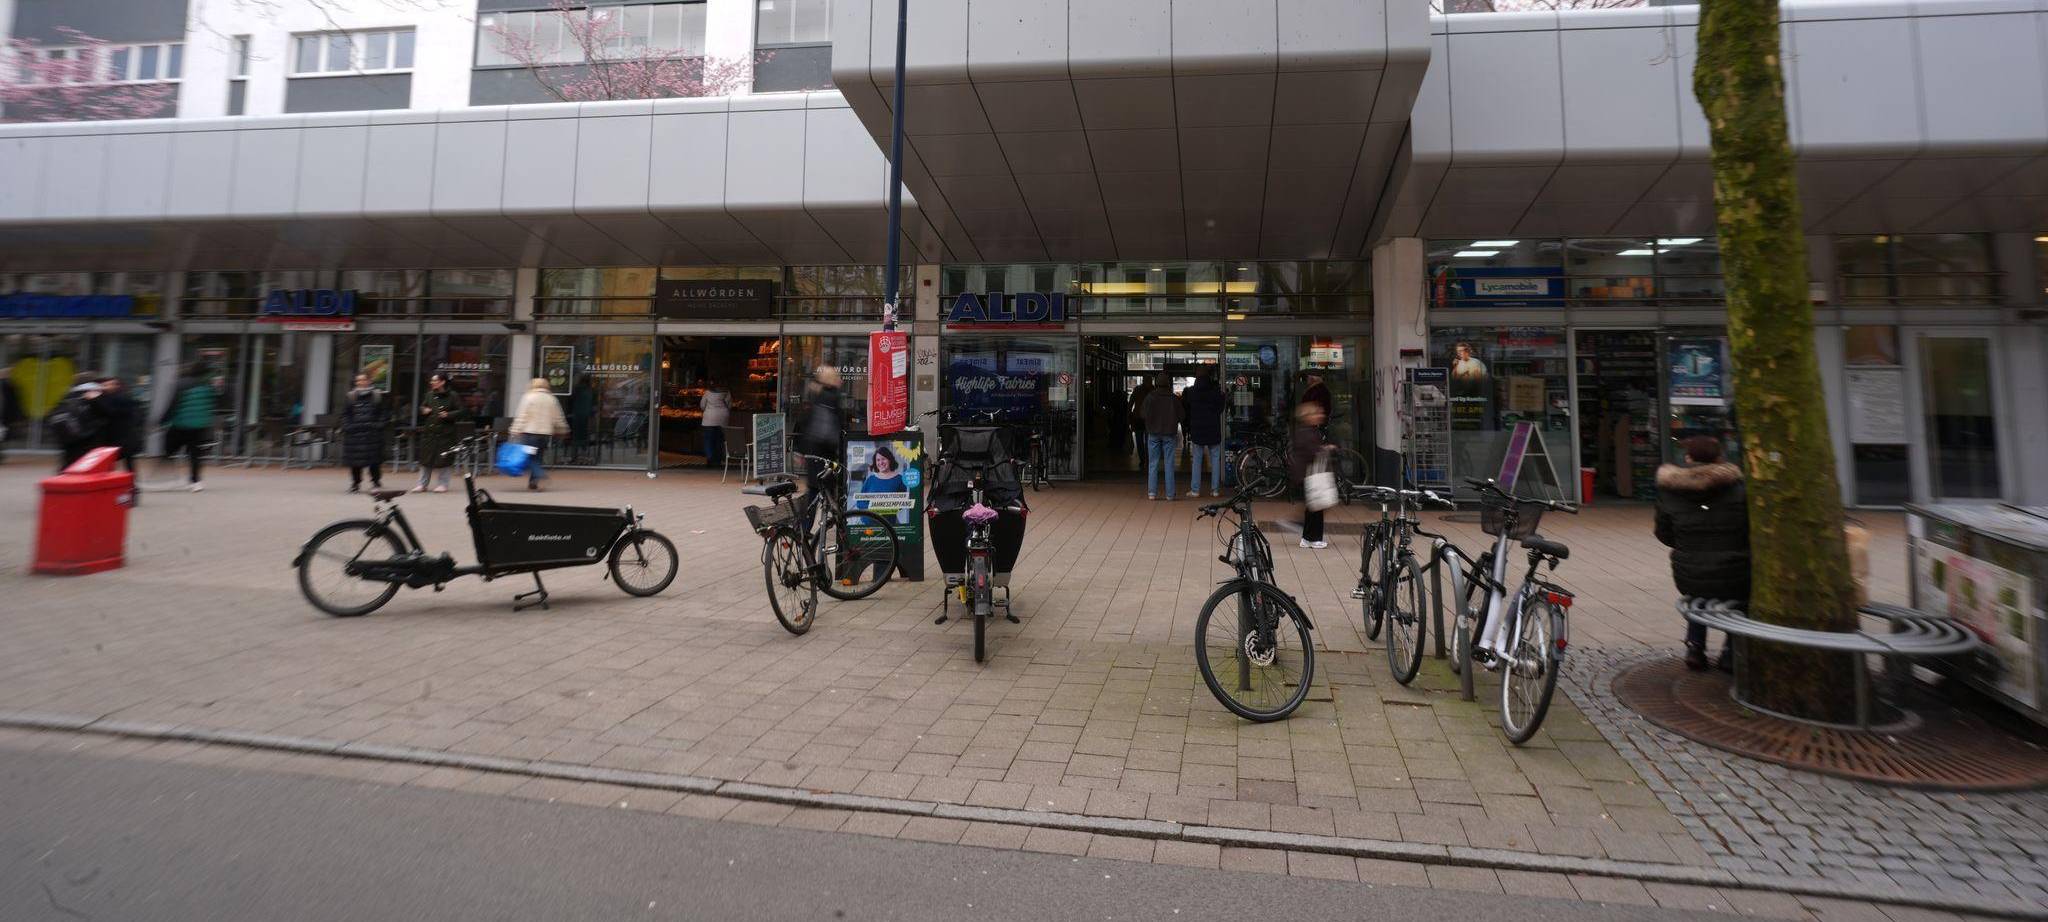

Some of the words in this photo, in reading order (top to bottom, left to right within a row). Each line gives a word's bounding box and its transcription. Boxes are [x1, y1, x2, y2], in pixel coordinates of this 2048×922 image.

[673, 287, 755, 297] ALLWÖRDEN
[1481, 281, 1538, 291] Lycamobile
[263, 289, 353, 315] ALDI
[946, 291, 1064, 321] ALDI
[954, 376, 996, 394] Highlife
[997, 375, 1036, 390] Fabrics
